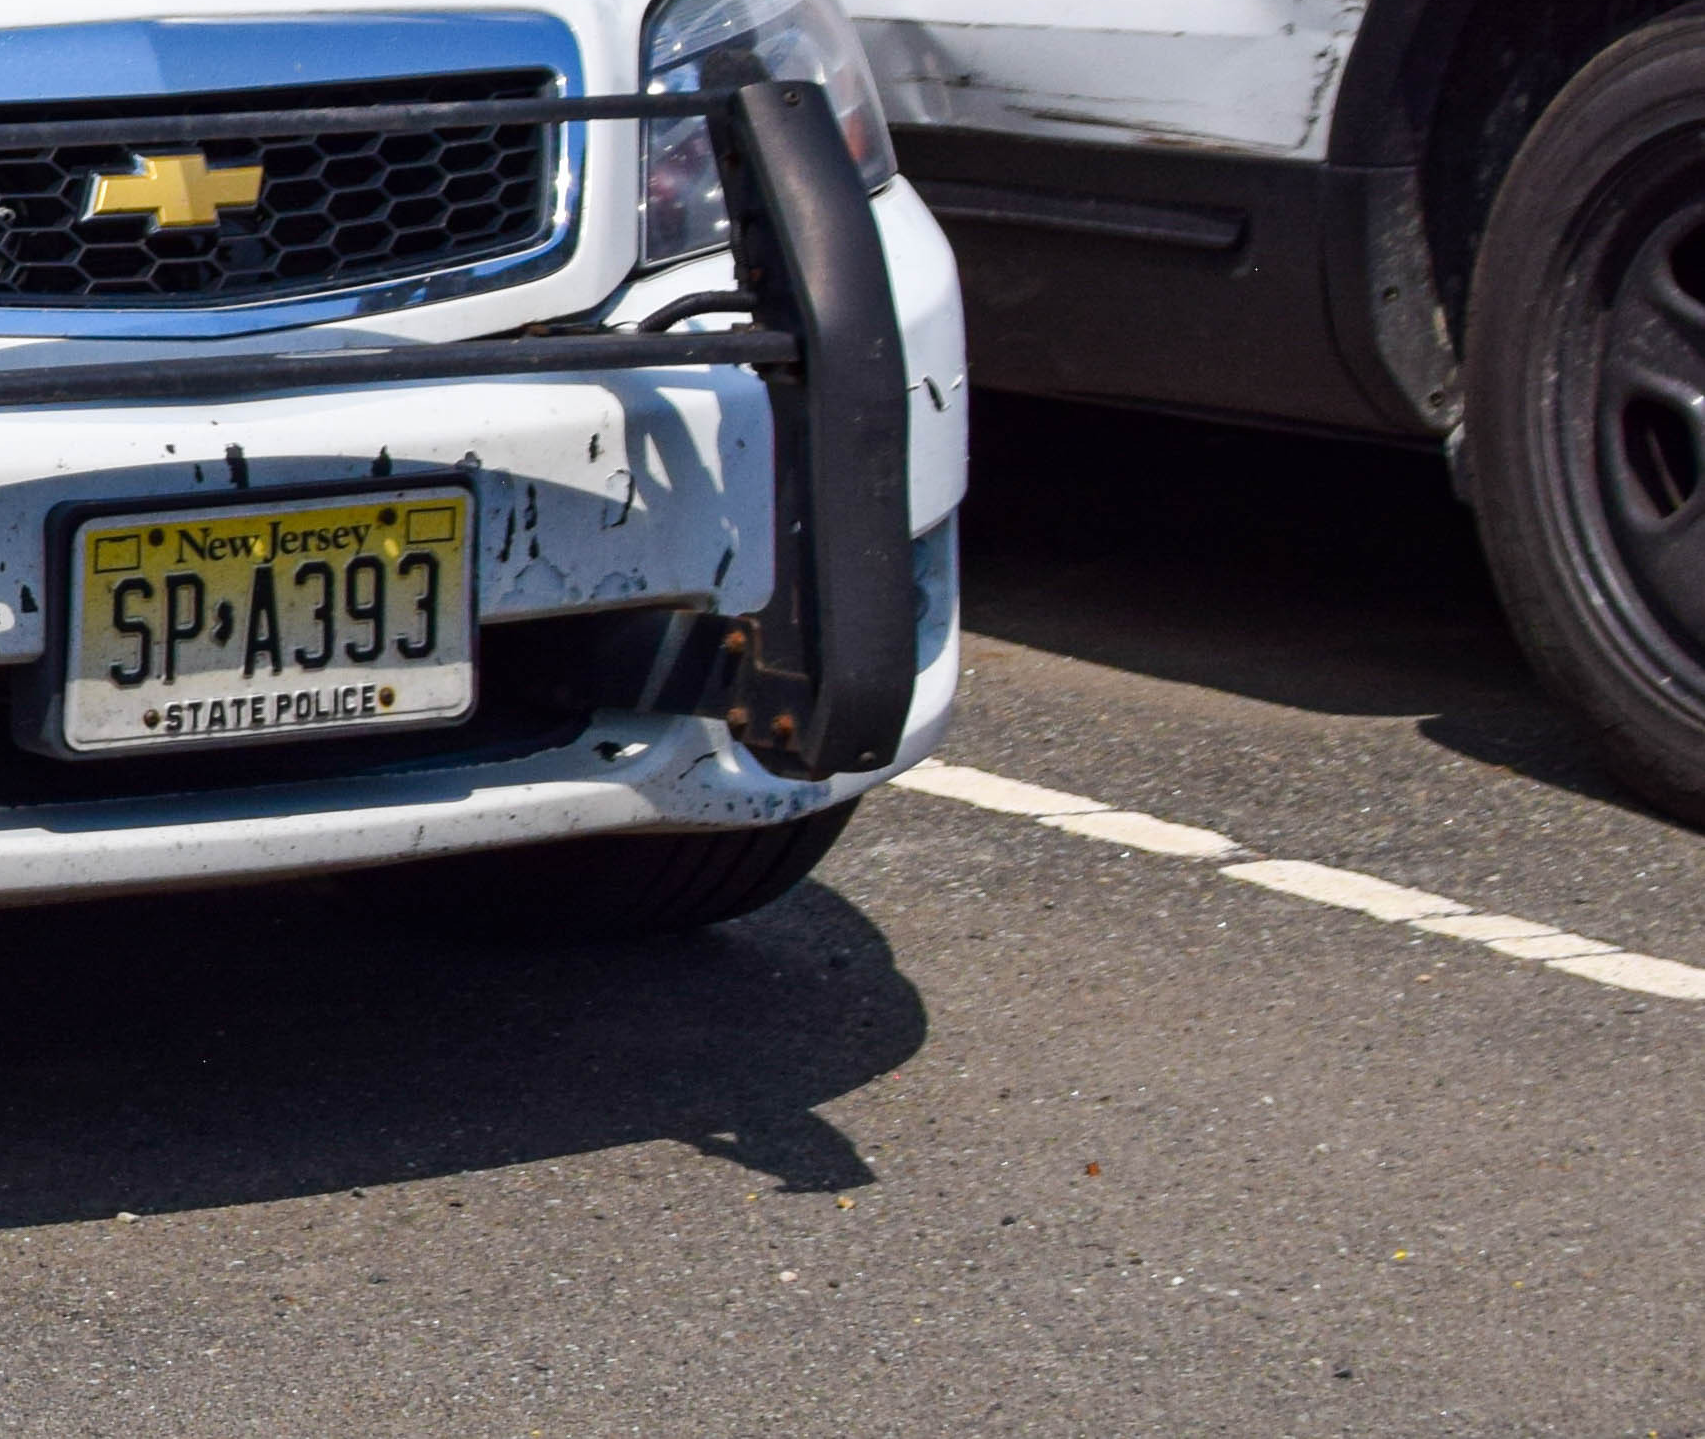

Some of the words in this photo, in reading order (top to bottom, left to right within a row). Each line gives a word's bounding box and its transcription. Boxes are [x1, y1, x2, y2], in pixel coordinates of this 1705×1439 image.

[176, 528, 264, 564] New
[261, 521, 373, 564] Jersey
[242, 550, 442, 680] A393
[162, 694, 266, 733] STATE
[275, 683, 378, 724] POLICE
